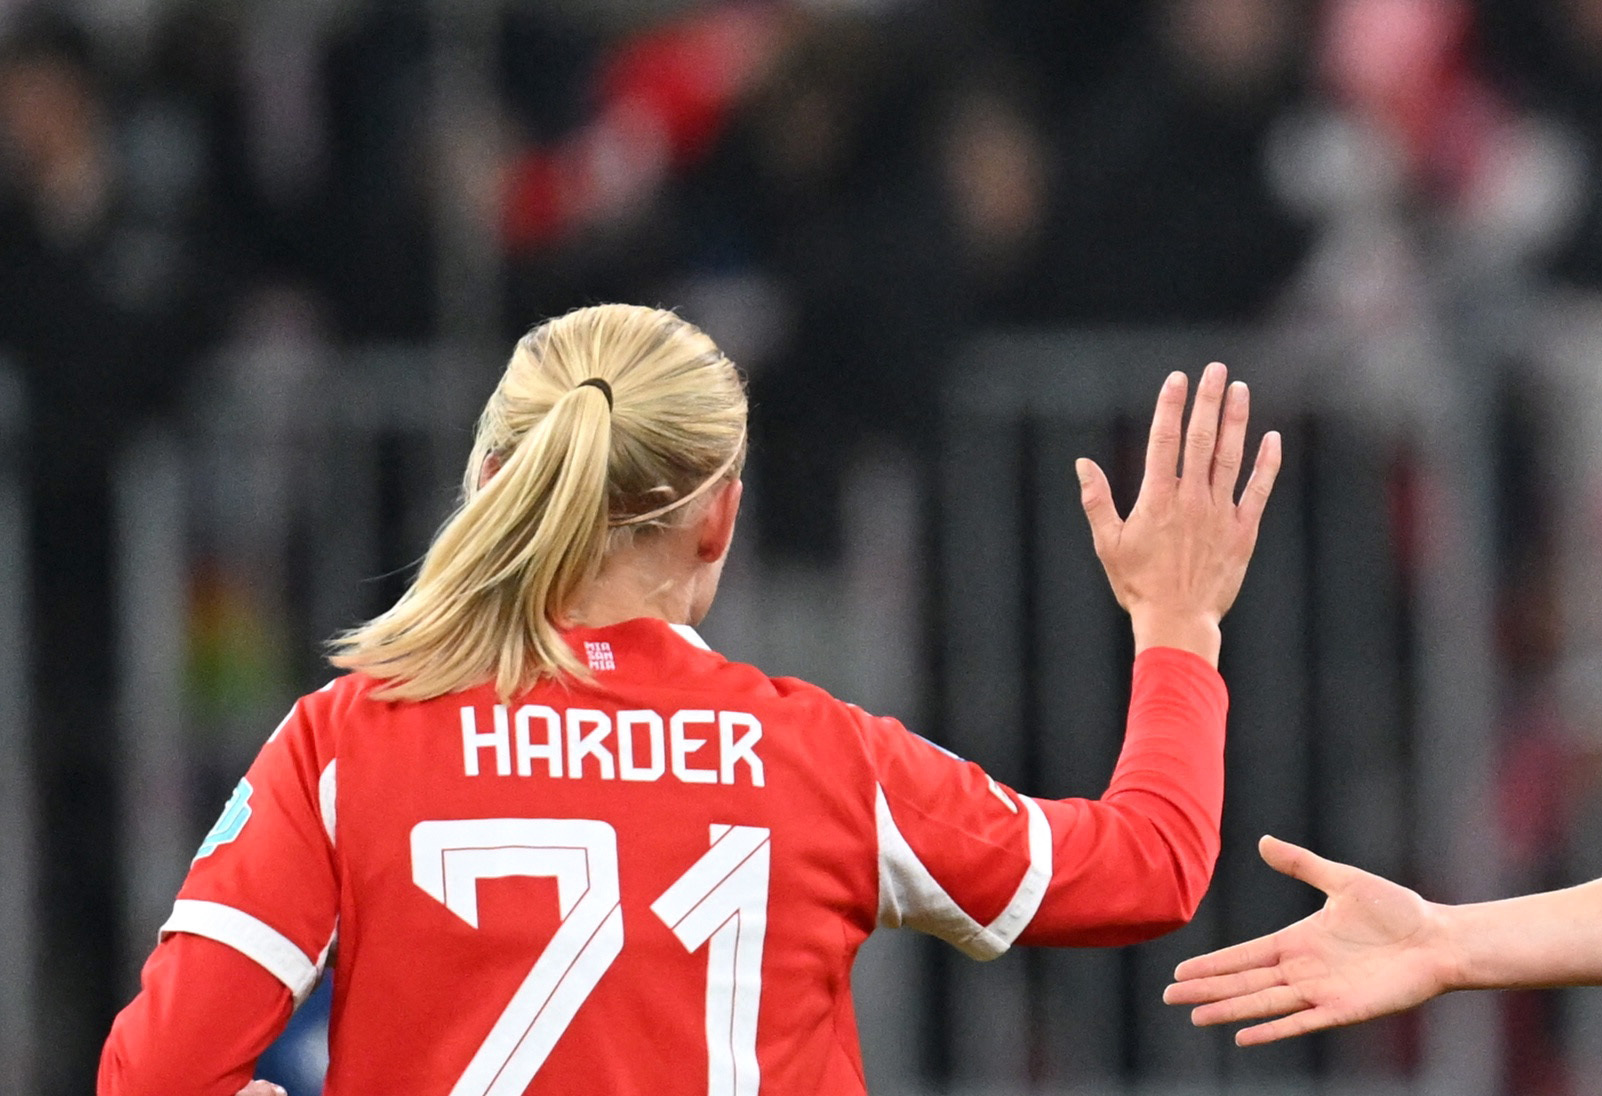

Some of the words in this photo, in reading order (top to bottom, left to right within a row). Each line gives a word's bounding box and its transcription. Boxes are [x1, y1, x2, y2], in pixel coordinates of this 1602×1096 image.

[583, 641, 611, 651] MIA
[586, 651, 614, 660] SAN
[588, 660, 616, 670] MIA
[460, 704, 766, 788] HARDER
